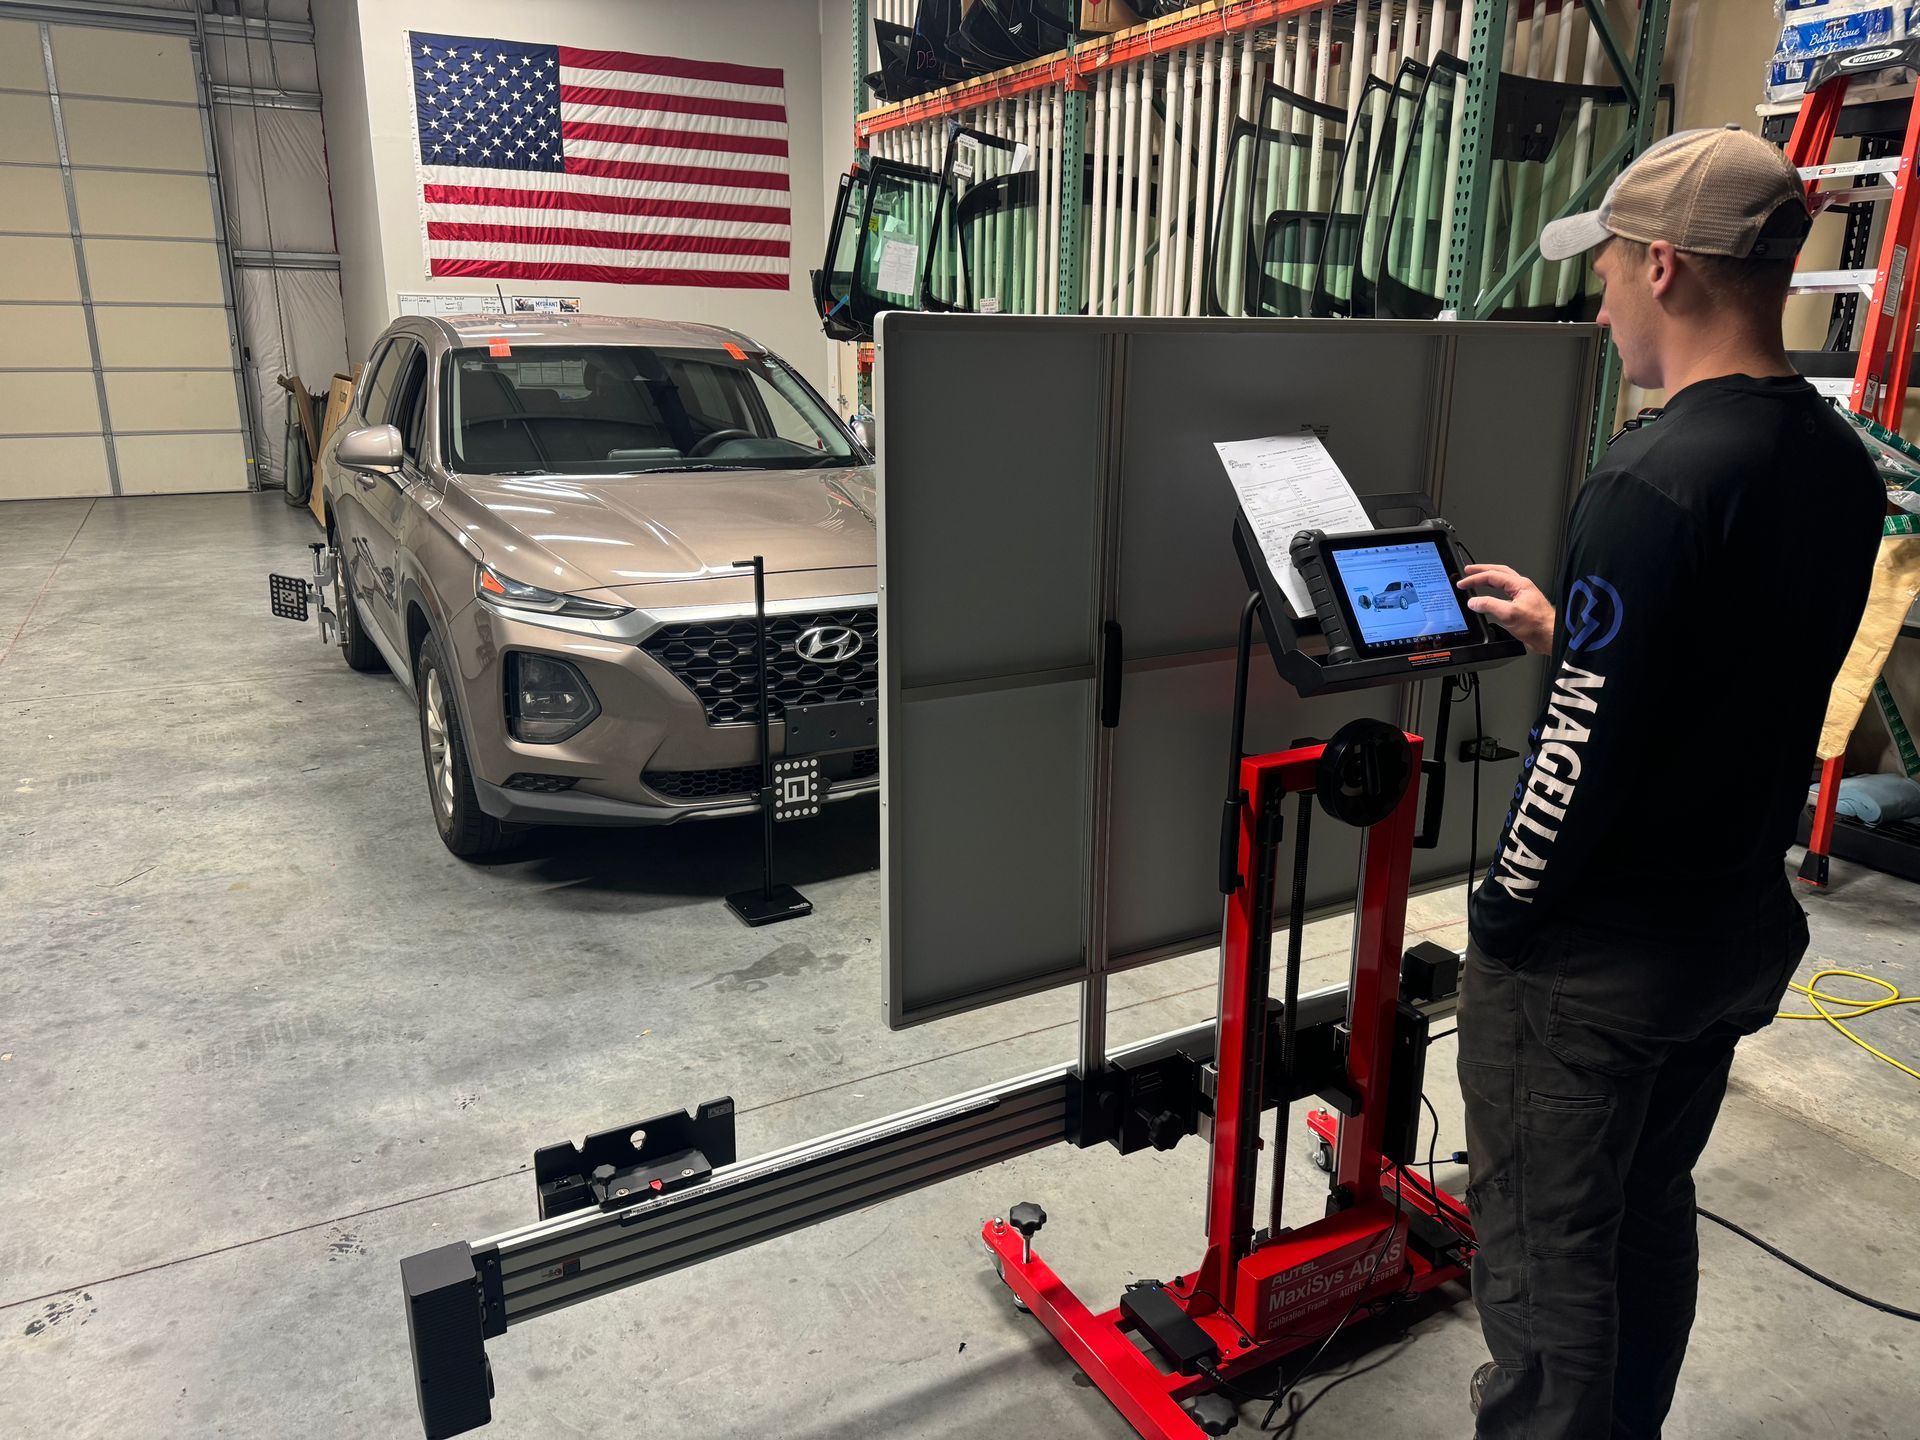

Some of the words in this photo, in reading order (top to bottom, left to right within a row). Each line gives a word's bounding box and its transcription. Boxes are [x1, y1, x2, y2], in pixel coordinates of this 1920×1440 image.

[1810, 32, 1833, 46] Bath
[1834, 26, 1860, 40] Tissue
[1852, 51, 1891, 63] WERNER
[1494, 660, 1606, 904] MAGELLAN
[1269, 1270, 1345, 1313] MaxiSys
[1349, 1243, 1401, 1280] ADAS
[1271, 1261, 1320, 1287] AUTEL
[1268, 1305, 1306, 1331] Calibration
[1307, 1298, 1329, 1315] Frame
